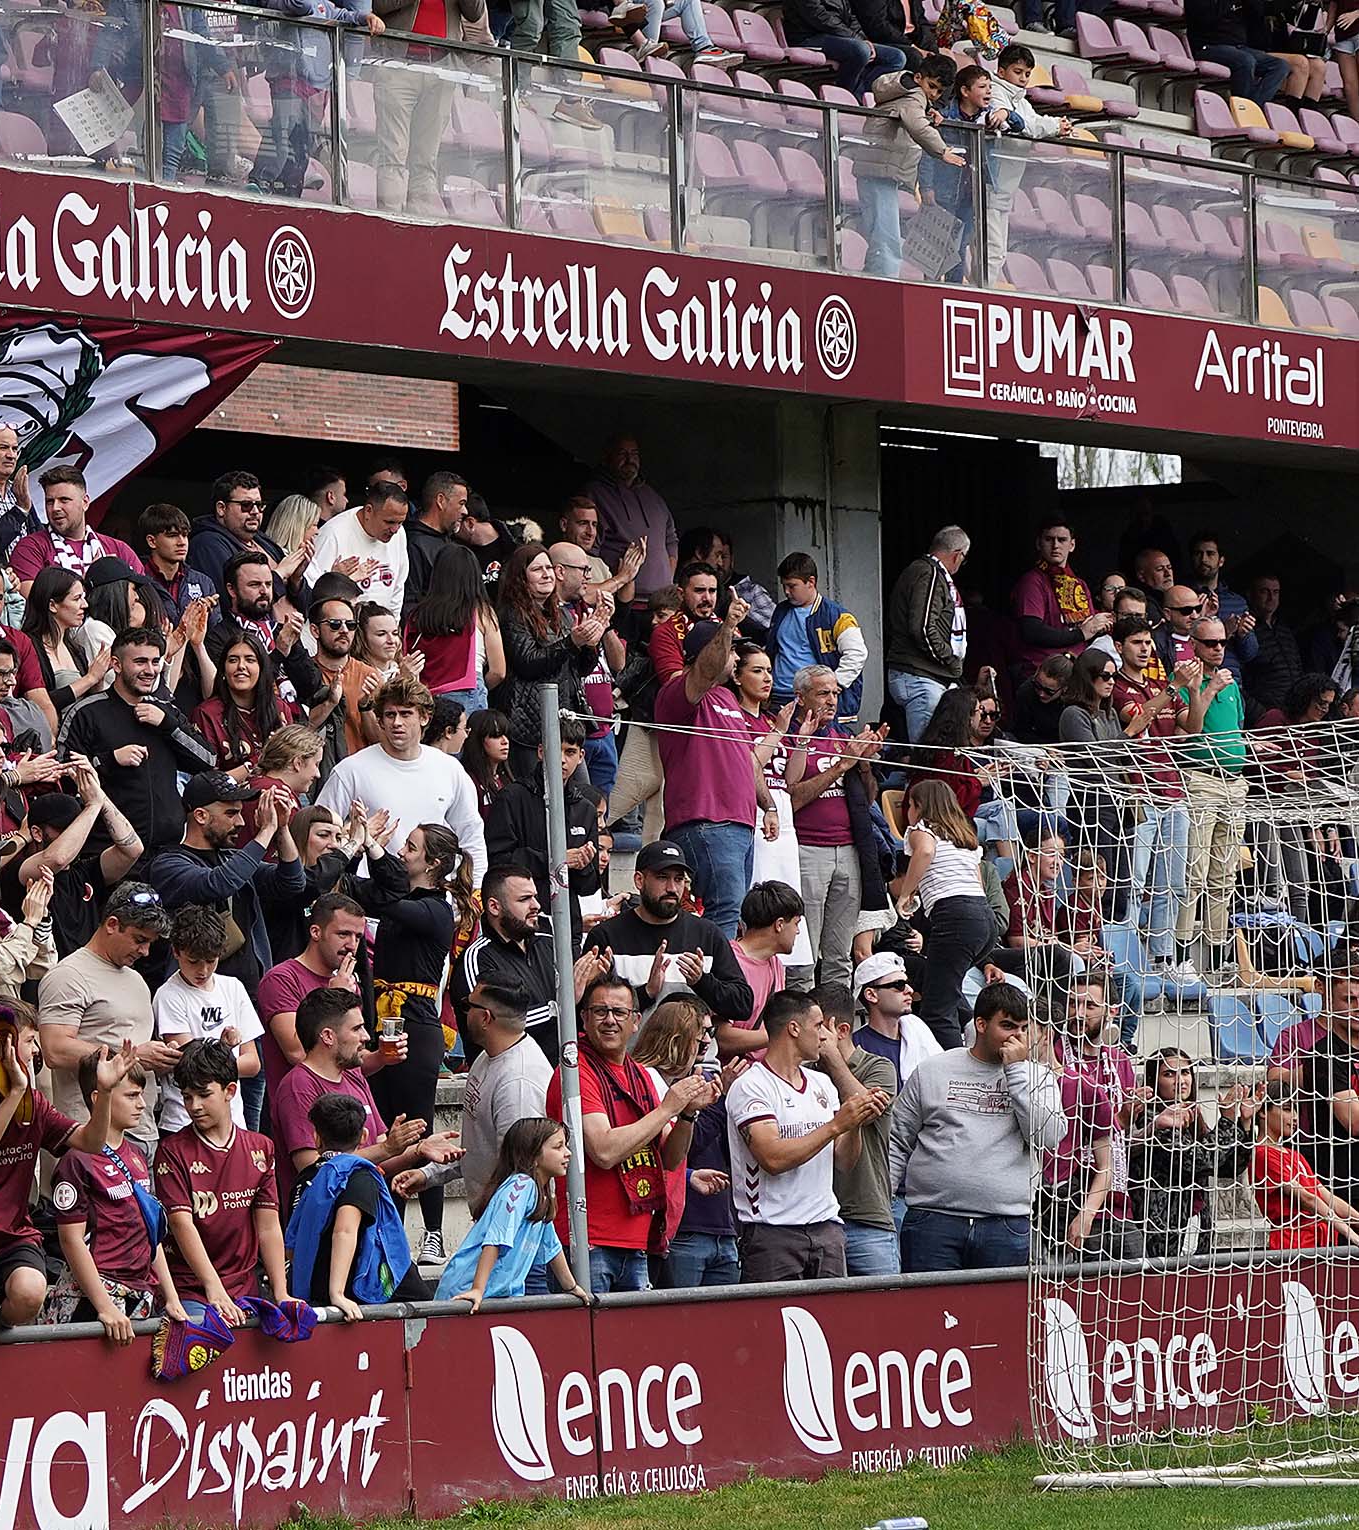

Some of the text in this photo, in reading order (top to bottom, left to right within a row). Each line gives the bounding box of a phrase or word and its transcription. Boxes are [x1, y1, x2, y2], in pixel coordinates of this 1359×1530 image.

[52, 191, 251, 314] Galicia
[439, 242, 805, 376] Estrella Galicia
[988, 304, 1137, 383] PUMAR
[988, 381, 1137, 414] CERÁMICA BAÑO COCINA
[1194, 328, 1324, 408] Arrital
[1267, 417, 1324, 440] PONTEVEDRA
[223, 1364, 293, 1403] tiendas
[557, 1362, 703, 1457] ence
[843, 1347, 973, 1431] ence
[1104, 1332, 1219, 1417] ence
[122, 1381, 391, 1527] Dispaint
[629, 1473, 641, 1495] &
[643, 1463, 707, 1493] CELULOSA
